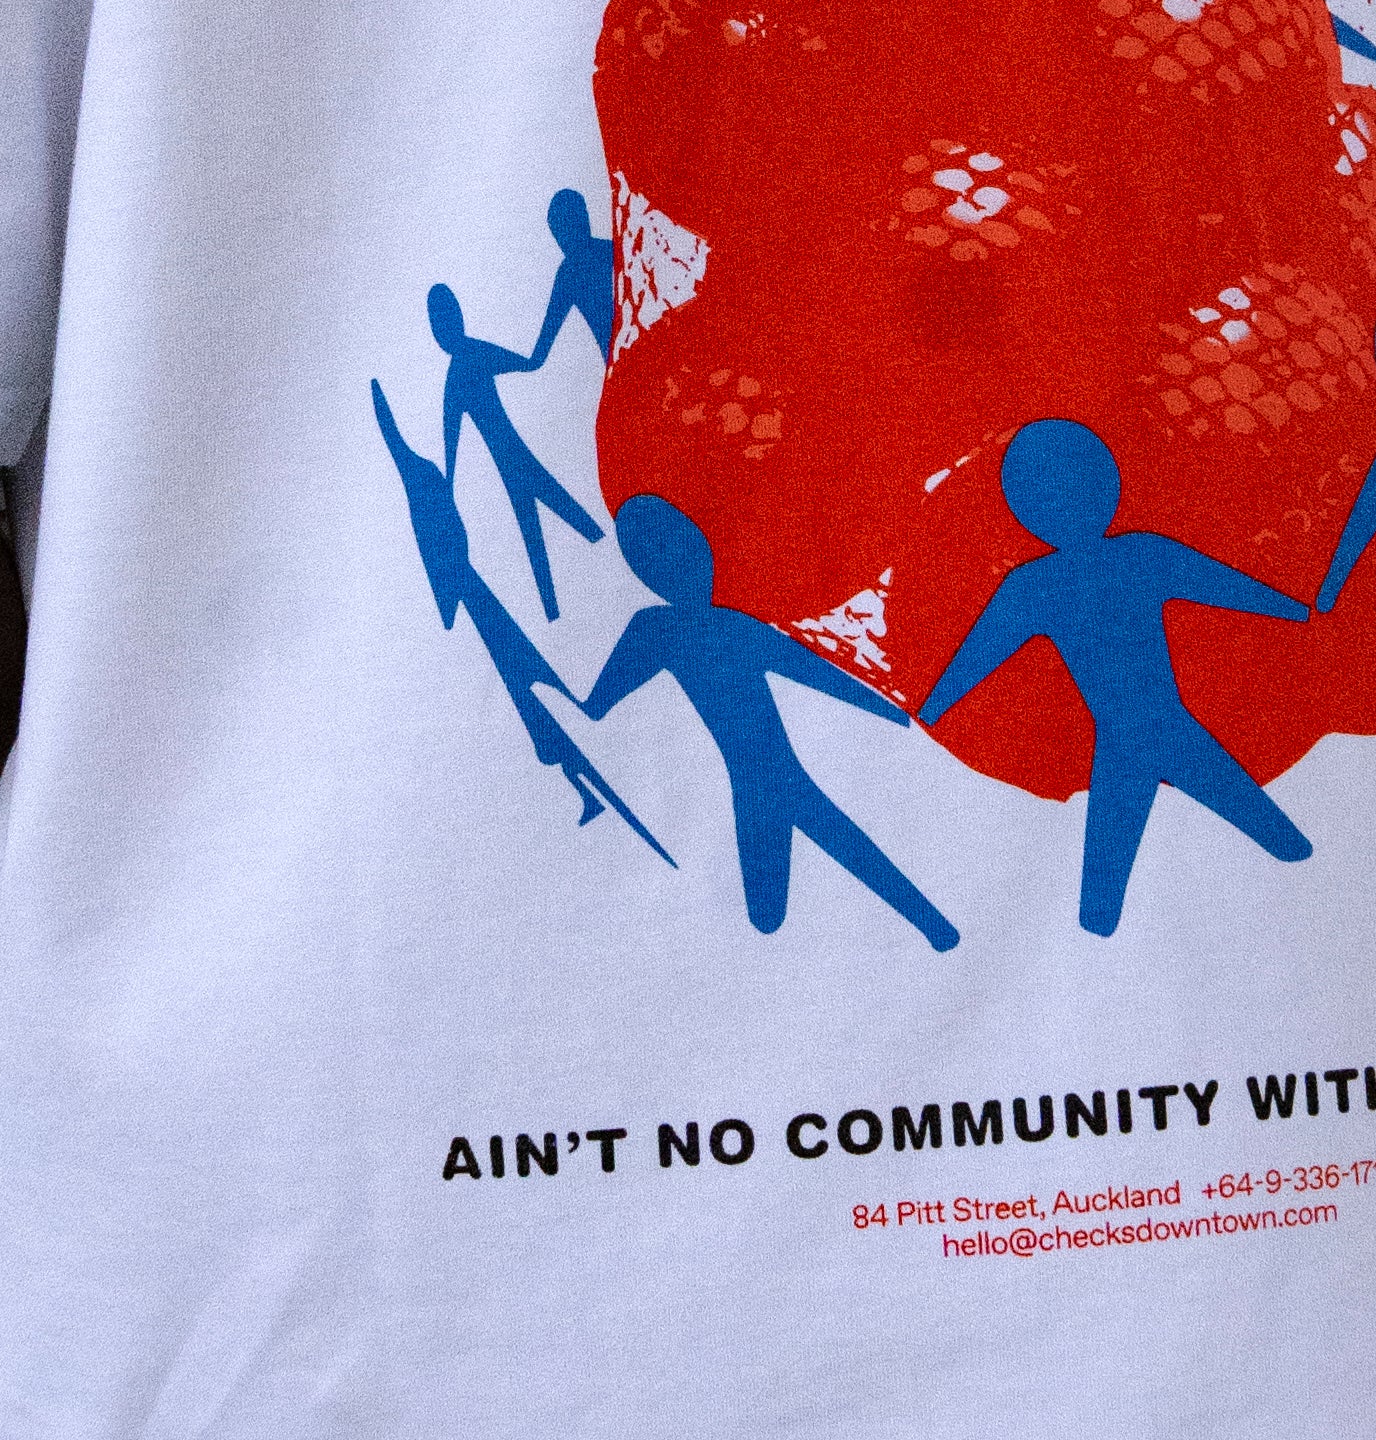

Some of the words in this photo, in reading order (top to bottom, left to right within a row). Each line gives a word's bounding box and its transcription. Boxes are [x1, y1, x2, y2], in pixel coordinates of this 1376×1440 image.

[441, 1127, 628, 1181] AIN’T
[657, 1118, 756, 1168] NO
[785, 1079, 1220, 1160] COMMUNITY
[851, 1203, 890, 1230] 84
[896, 1199, 946, 1226] Pitt
[952, 1194, 1047, 1224] Street,
[1052, 1180, 1183, 1216] Auckland
[941, 1203, 1338, 1259] hello@checksdowntown.com
